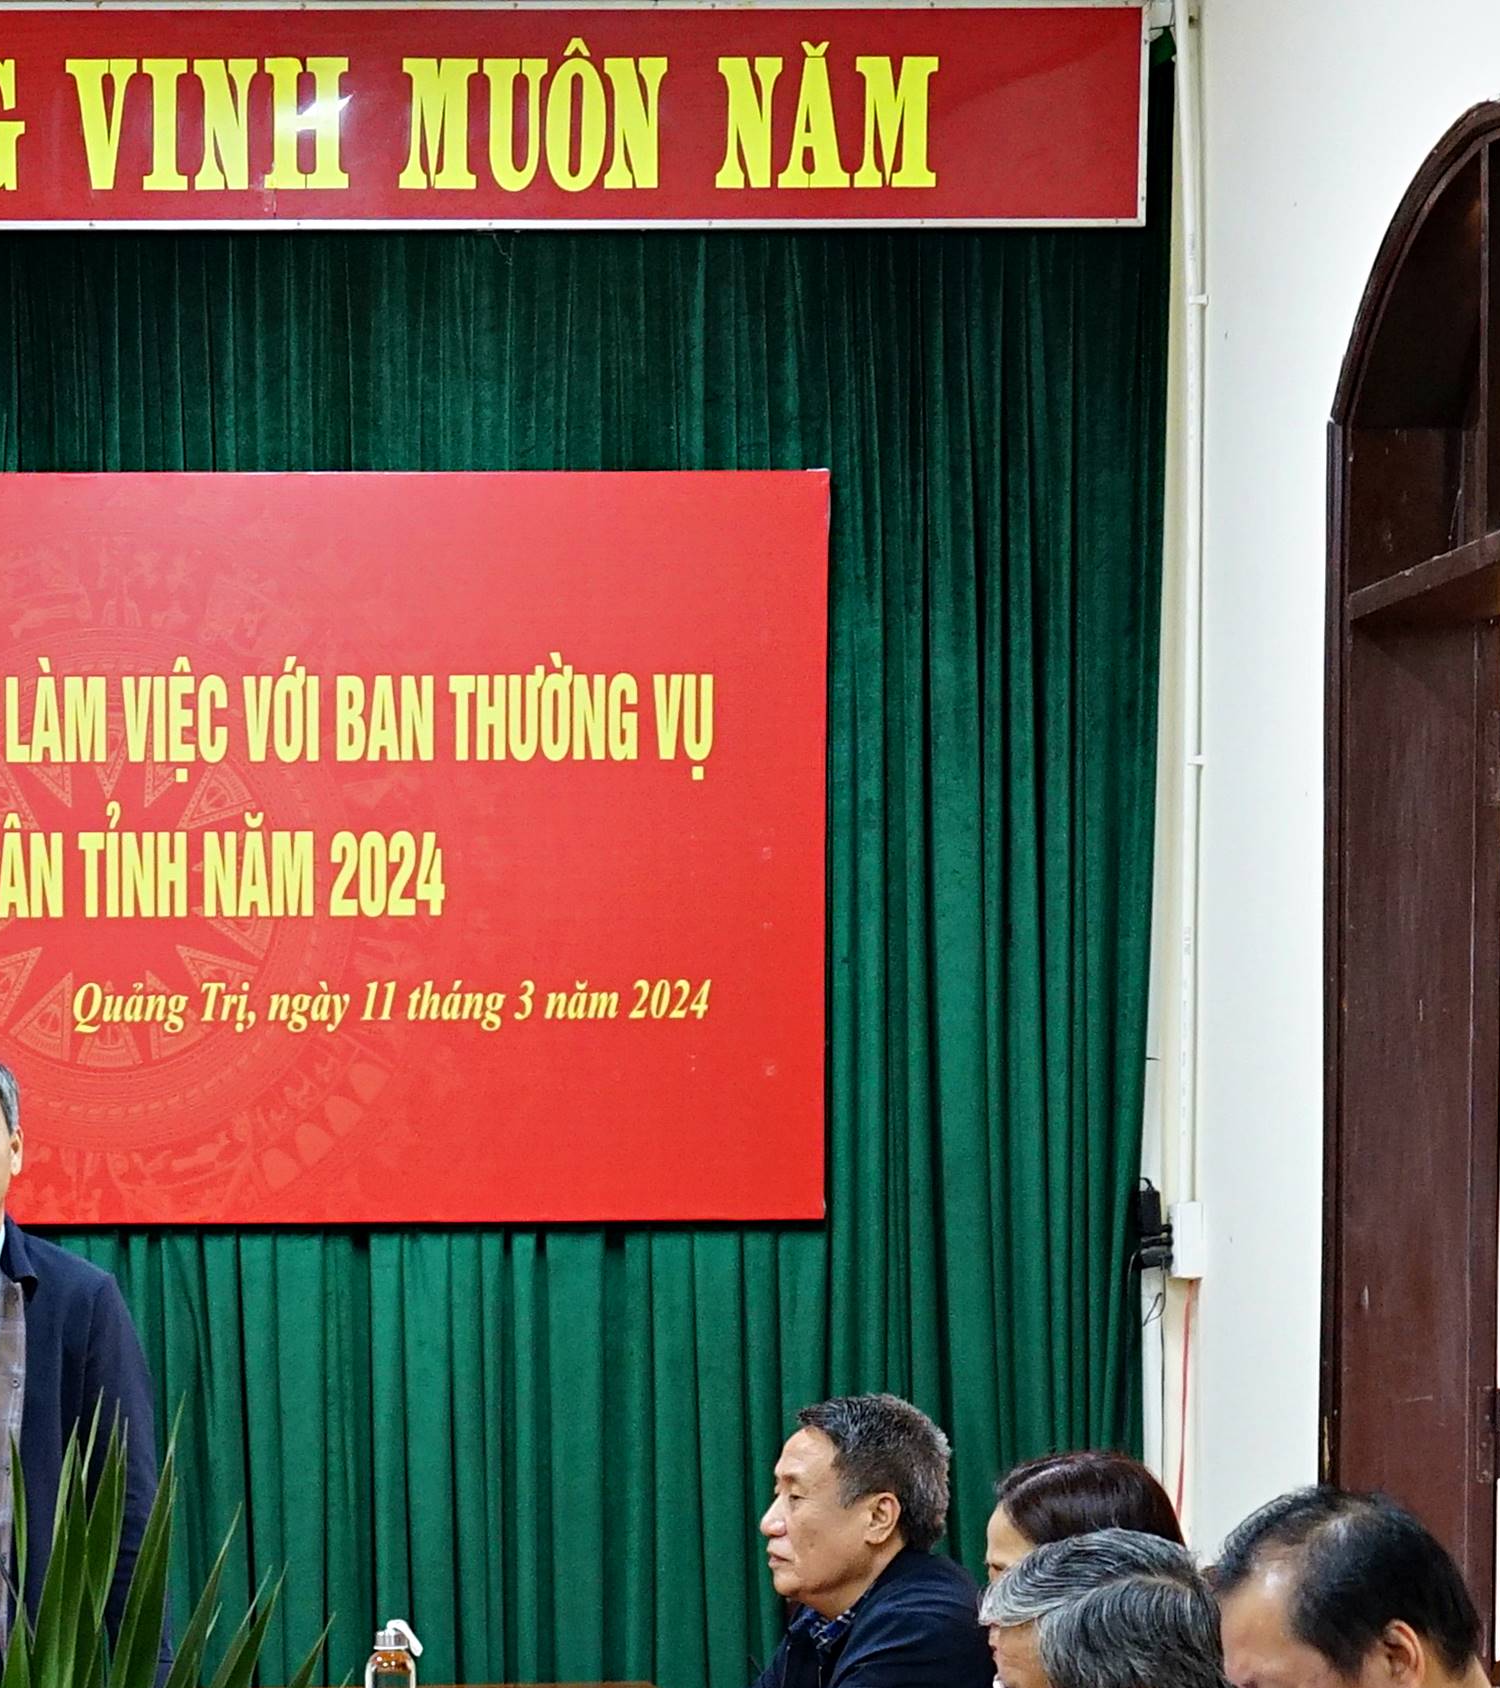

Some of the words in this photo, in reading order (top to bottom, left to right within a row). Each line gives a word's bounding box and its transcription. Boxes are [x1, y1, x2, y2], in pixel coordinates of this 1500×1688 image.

[64, 56, 350, 194] VINH
[400, 37, 670, 193] MUÔN
[716, 41, 941, 190] NĂM
[6, 659, 107, 764] LÀM
[124, 658, 229, 783] VIỆC
[244, 658, 320, 764] VỚI
[337, 675, 436, 763] BAN
[449, 653, 640, 762] THƯỜNG
[653, 674, 716, 782] VỤ
[78, 801, 190, 919] TỈNH
[203, 813, 316, 919] NĂM
[329, 831, 448, 919] 2024
[72, 983, 188, 1036] Quảng
[202, 981, 258, 1033] Trị,
[268, 990, 350, 1032] ngày
[363, 982, 398, 1022] 11
[407, 980, 506, 1032] tháng
[515, 981, 537, 1022] 3
[545, 984, 620, 1021] năm
[630, 979, 712, 1020] 2024
